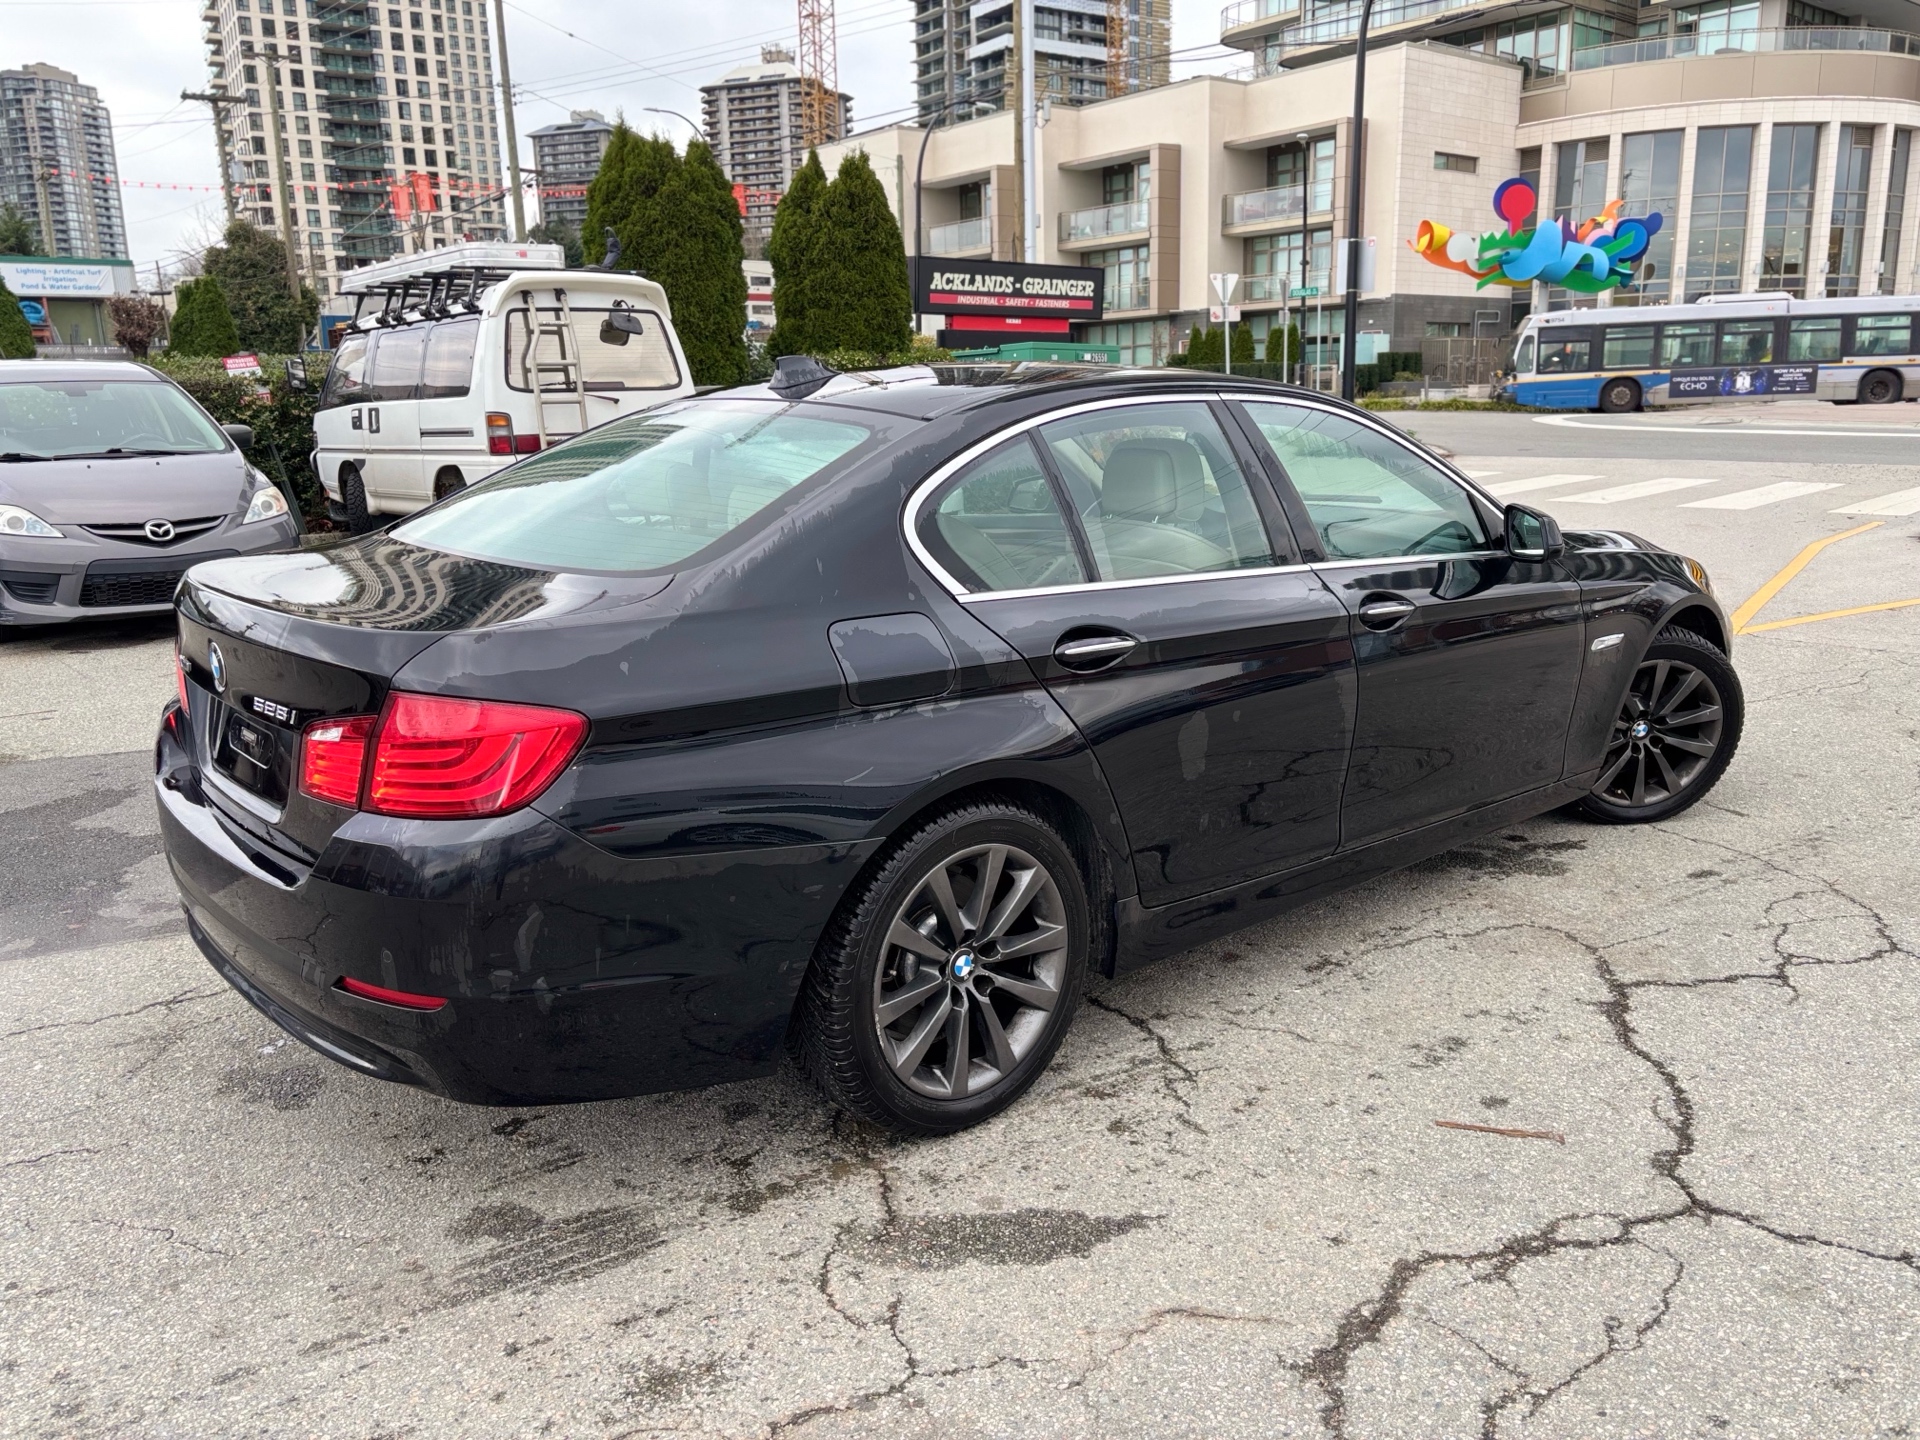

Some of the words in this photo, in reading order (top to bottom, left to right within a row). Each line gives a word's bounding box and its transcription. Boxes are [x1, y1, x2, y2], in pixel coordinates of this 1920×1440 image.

[957, 296, 998, 305] INDUSTRIAL
[1035, 300, 1070, 308] FASTENERS
[1091, 353, 1108, 362] 26550
